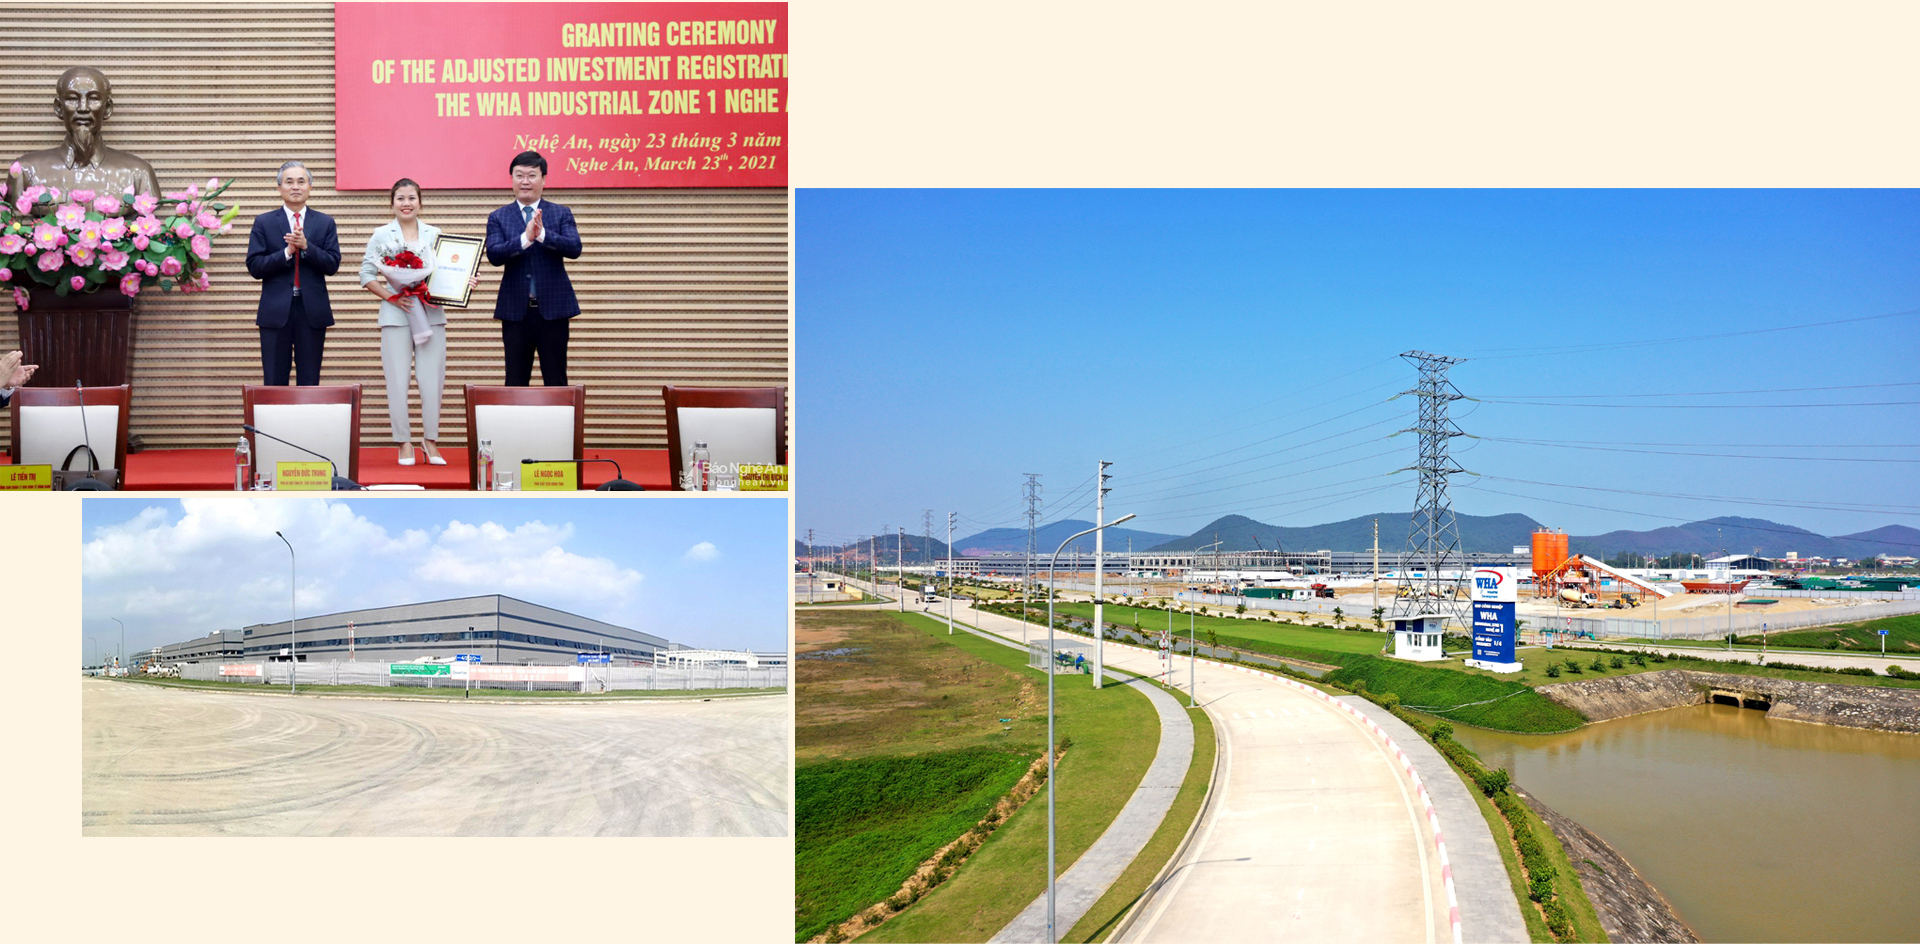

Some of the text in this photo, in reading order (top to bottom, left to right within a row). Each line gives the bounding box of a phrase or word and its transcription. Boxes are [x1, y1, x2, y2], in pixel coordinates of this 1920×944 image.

[561, 19, 777, 48] GRANTING CEREMONY
[371, 53, 788, 85] OF THE ADJUSTED INVESTMENT REGISTRATI
[434, 92, 471, 118] THE
[476, 91, 523, 117] WHA
[528, 90, 643, 117] INDUSTRIAL
[648, 89, 701, 115] ZONE
[706, 89, 717, 114] 1
[725, 88, 779, 114] NGHE
[513, 132, 782, 154] Nghệ An, ngày 23 tháng 3 năm
[566, 157, 608, 175] Nghe
[611, 157, 639, 173] An,
[644, 156, 696, 171] March
[738, 155, 776, 170] 2021
[1475, 577, 1498, 589] WHA
[1480, 611, 1498, 621] WHA
